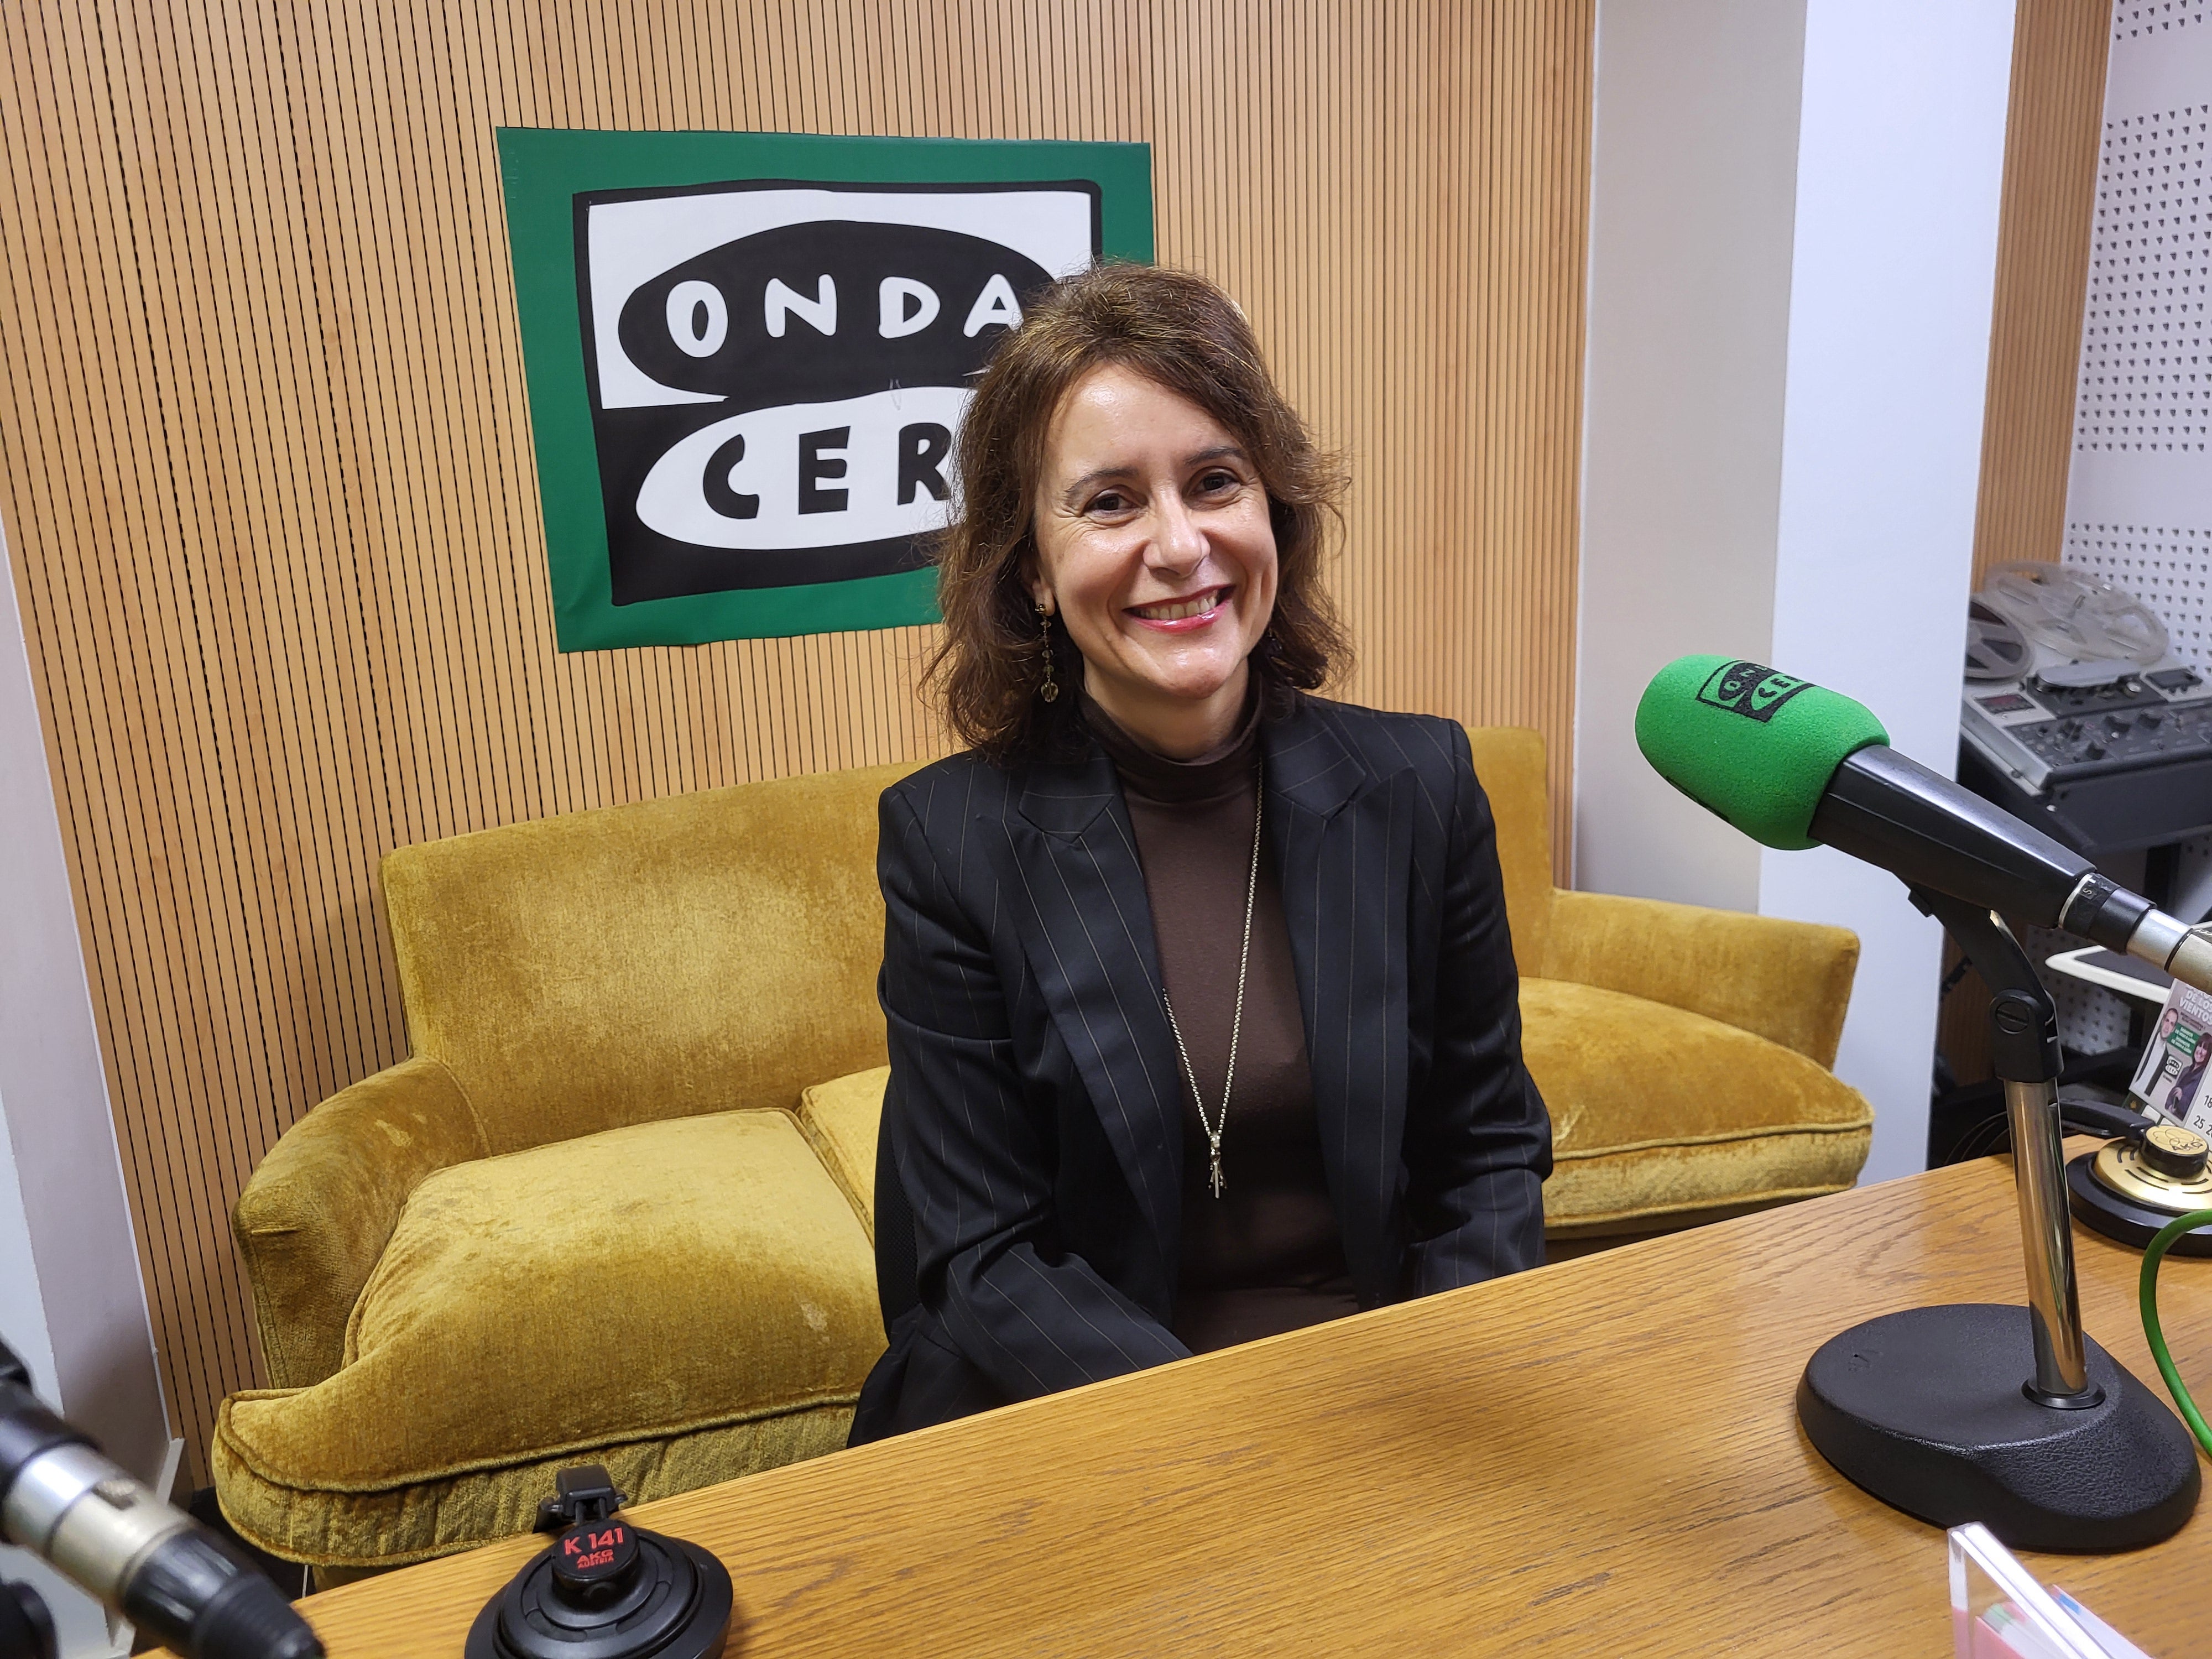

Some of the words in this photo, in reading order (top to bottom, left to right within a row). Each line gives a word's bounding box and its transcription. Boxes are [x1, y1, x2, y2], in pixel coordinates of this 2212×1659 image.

[666, 274, 1024, 358] ONDA
[703, 422, 951, 519] CER
[1724, 665, 1767, 691] ON
[1758, 675, 1801, 698] CE
[2185, 990, 2198, 1003] DE
[2179, 996, 2212, 1026] VIENTOS
[2193, 1115, 2205, 1129] 25
[2206, 1124, 2212, 1138] 2
[565, 1537, 582, 1555] K
[588, 1527, 623, 1549] 141
